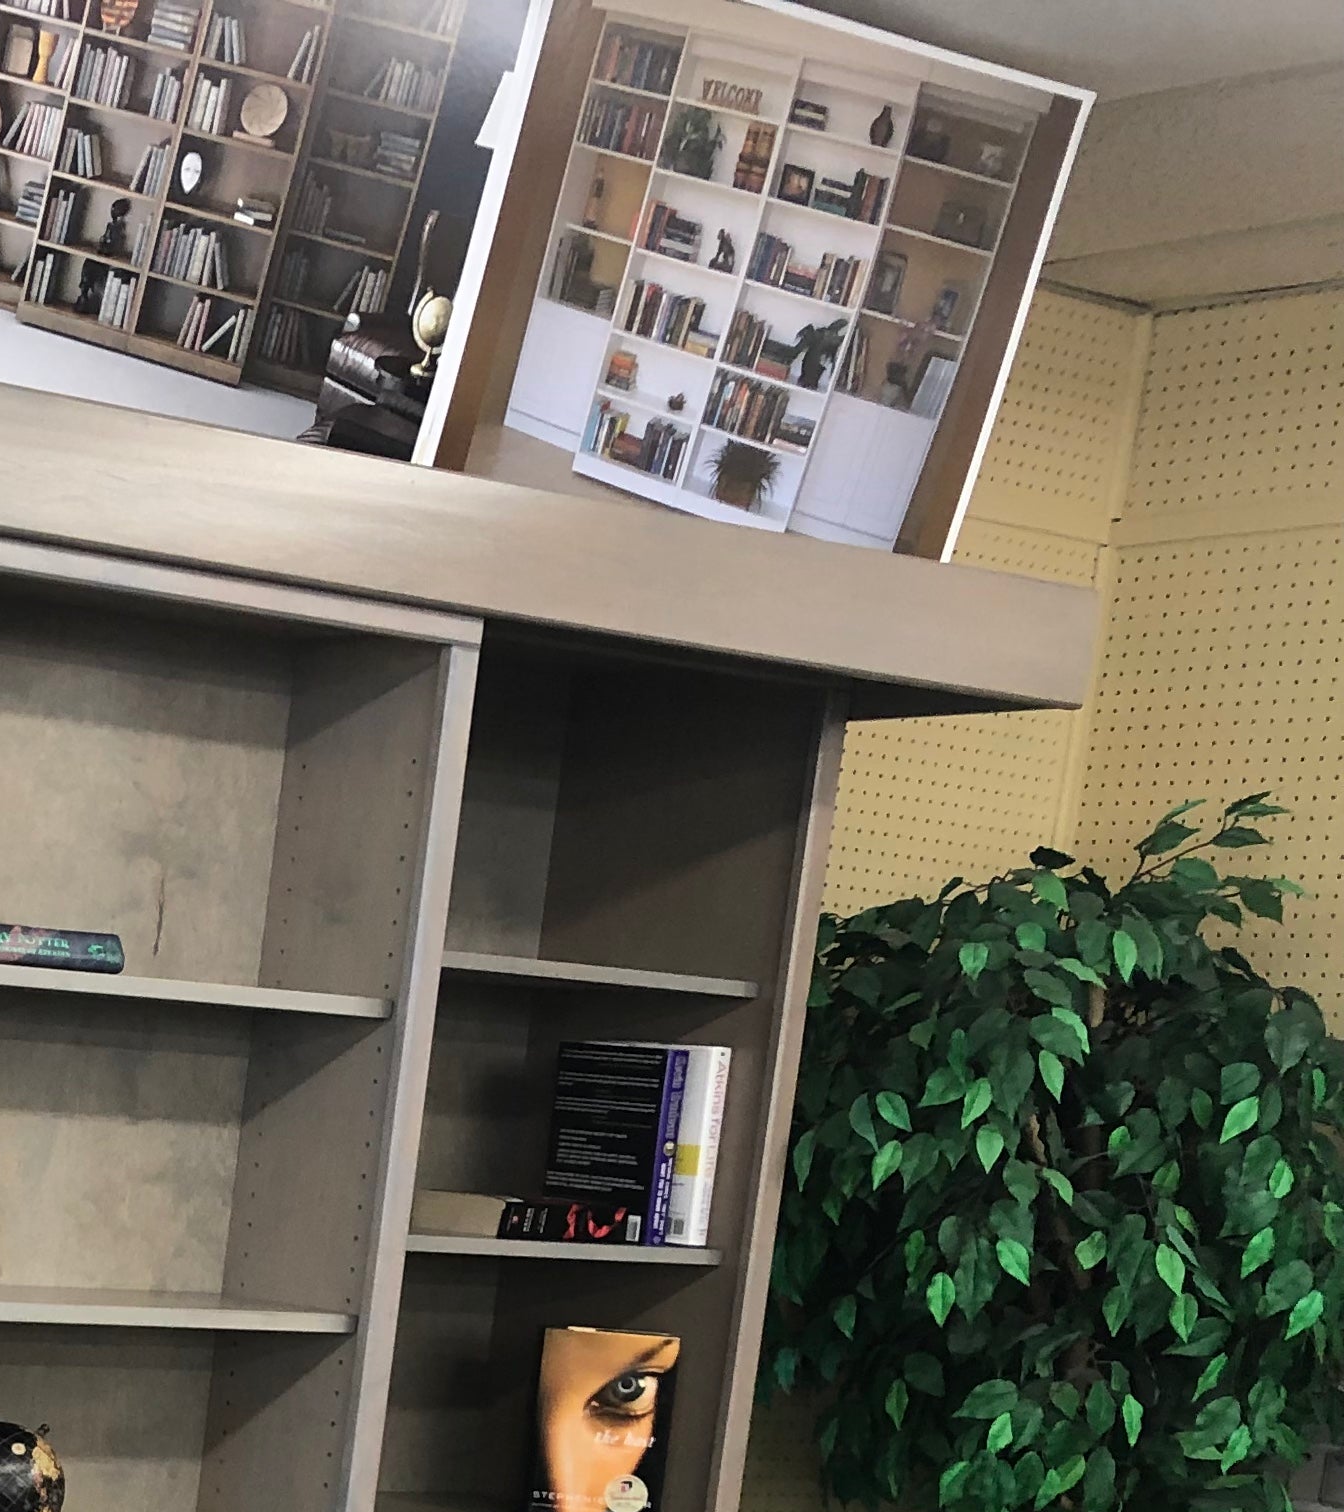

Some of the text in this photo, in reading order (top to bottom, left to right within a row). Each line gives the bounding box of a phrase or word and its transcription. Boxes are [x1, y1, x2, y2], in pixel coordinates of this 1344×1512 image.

[17, 933, 70, 949] POTTER
[711, 1060, 725, 1115] Atkins
[709, 1117, 722, 1142] for
